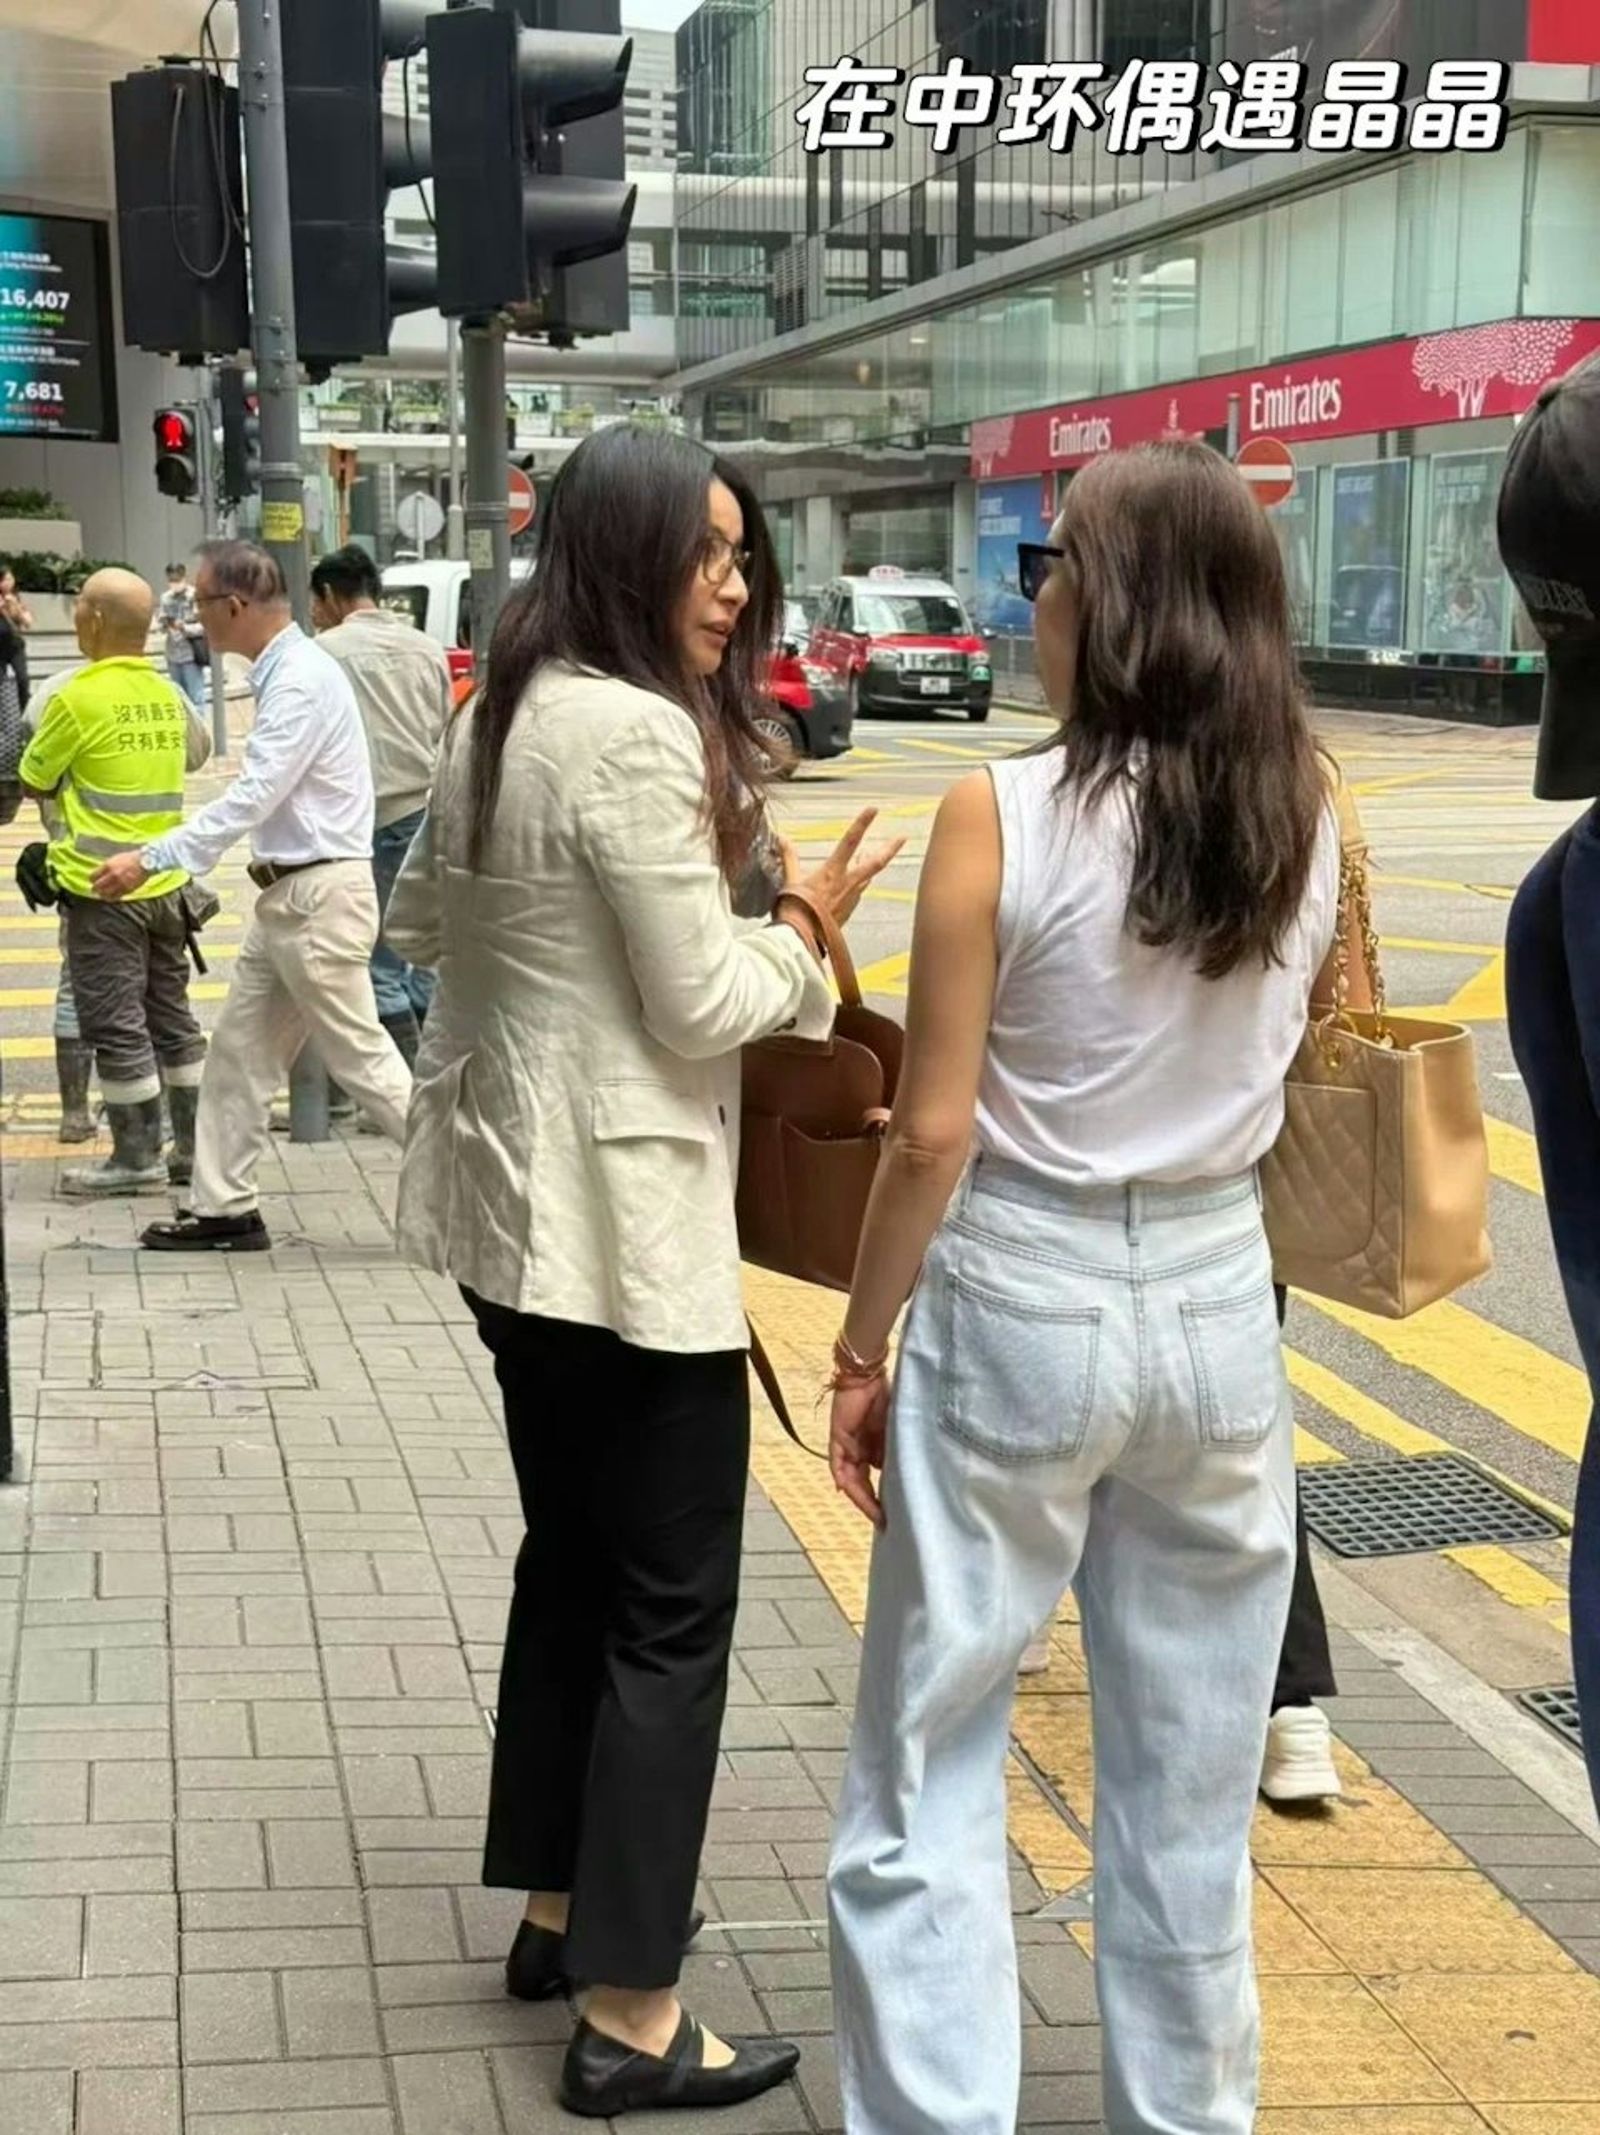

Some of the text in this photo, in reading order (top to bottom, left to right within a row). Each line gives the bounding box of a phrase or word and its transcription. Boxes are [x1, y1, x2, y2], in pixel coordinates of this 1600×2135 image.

[1, 288, 70, 310] 16,407
[4, 381, 64, 401] 7,681
[1249, 374, 1342, 432] Emirates
[1050, 413, 1112, 457] Emirates
[118, 730, 185, 752] 只有更安
